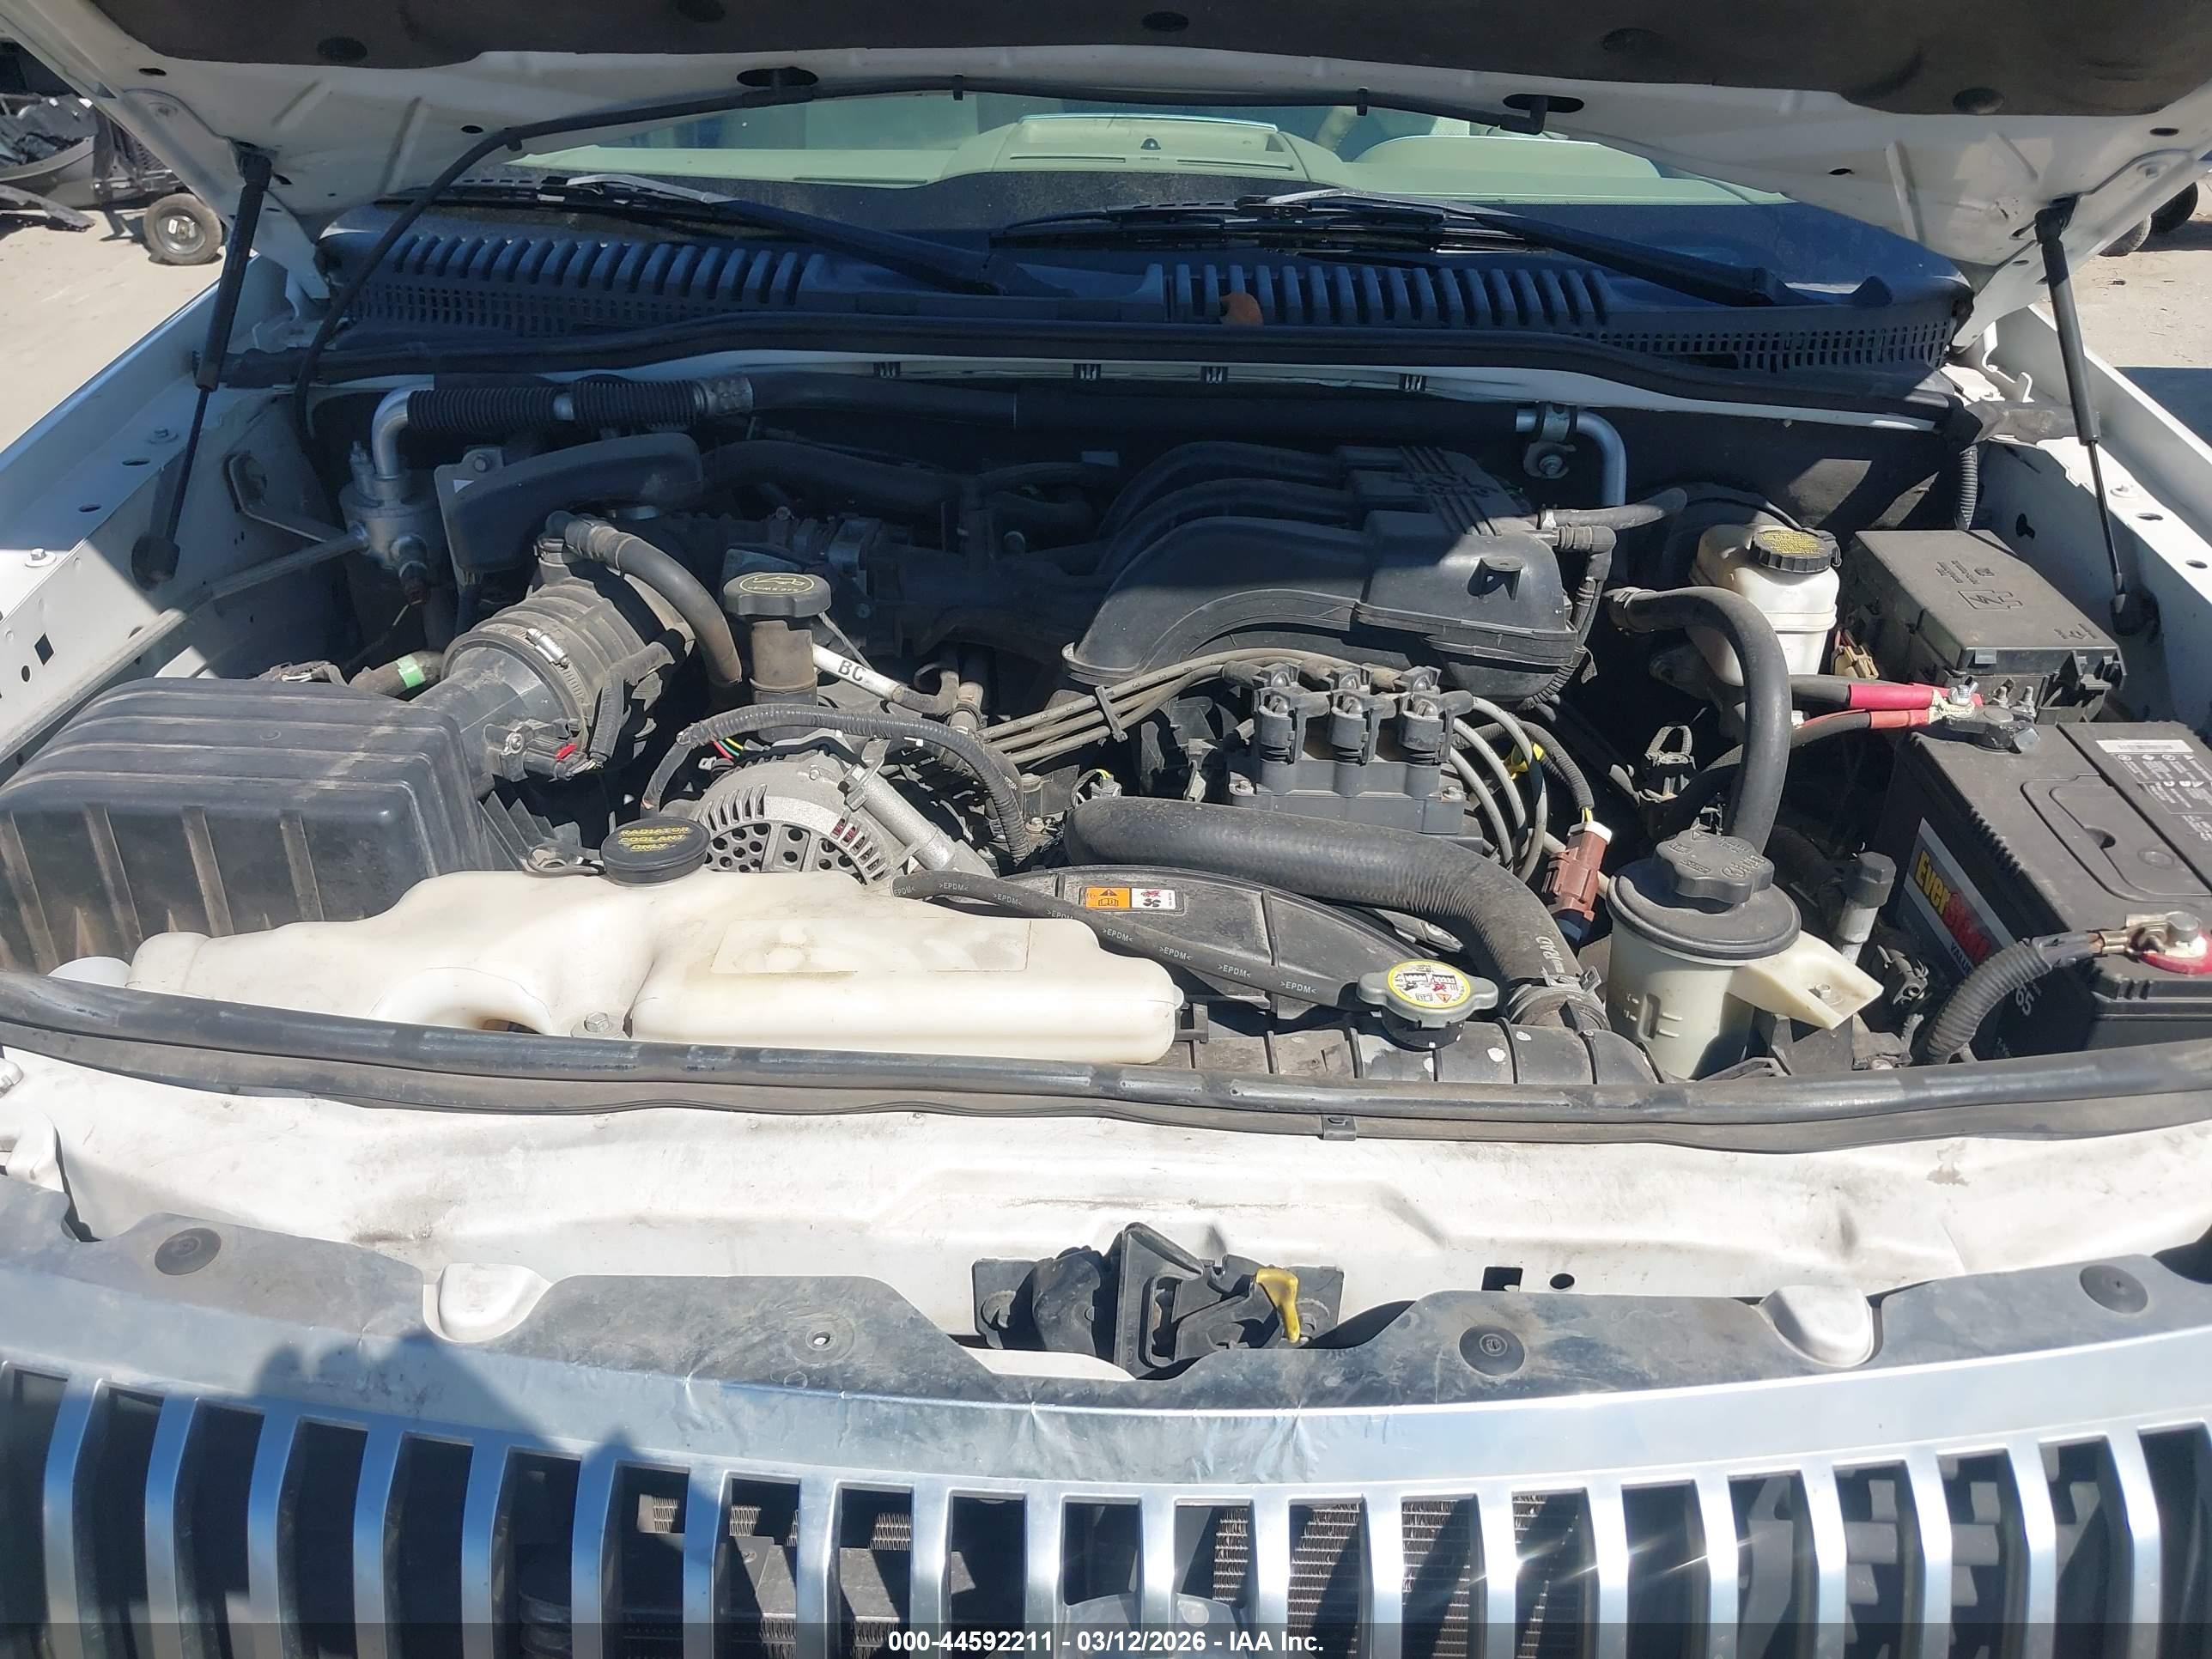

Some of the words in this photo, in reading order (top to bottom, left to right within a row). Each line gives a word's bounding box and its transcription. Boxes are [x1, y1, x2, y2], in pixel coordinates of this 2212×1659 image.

[838, 659, 866, 681] BC
[620, 827, 690, 837] RADIATOR
[618, 835, 686, 844] COOLANT
[631, 843, 667, 852] ONLY
[893, 885, 916, 897] EPDM<
[1914, 849, 1992, 967] EverS
[2015, 983, 2034, 1016] 65
